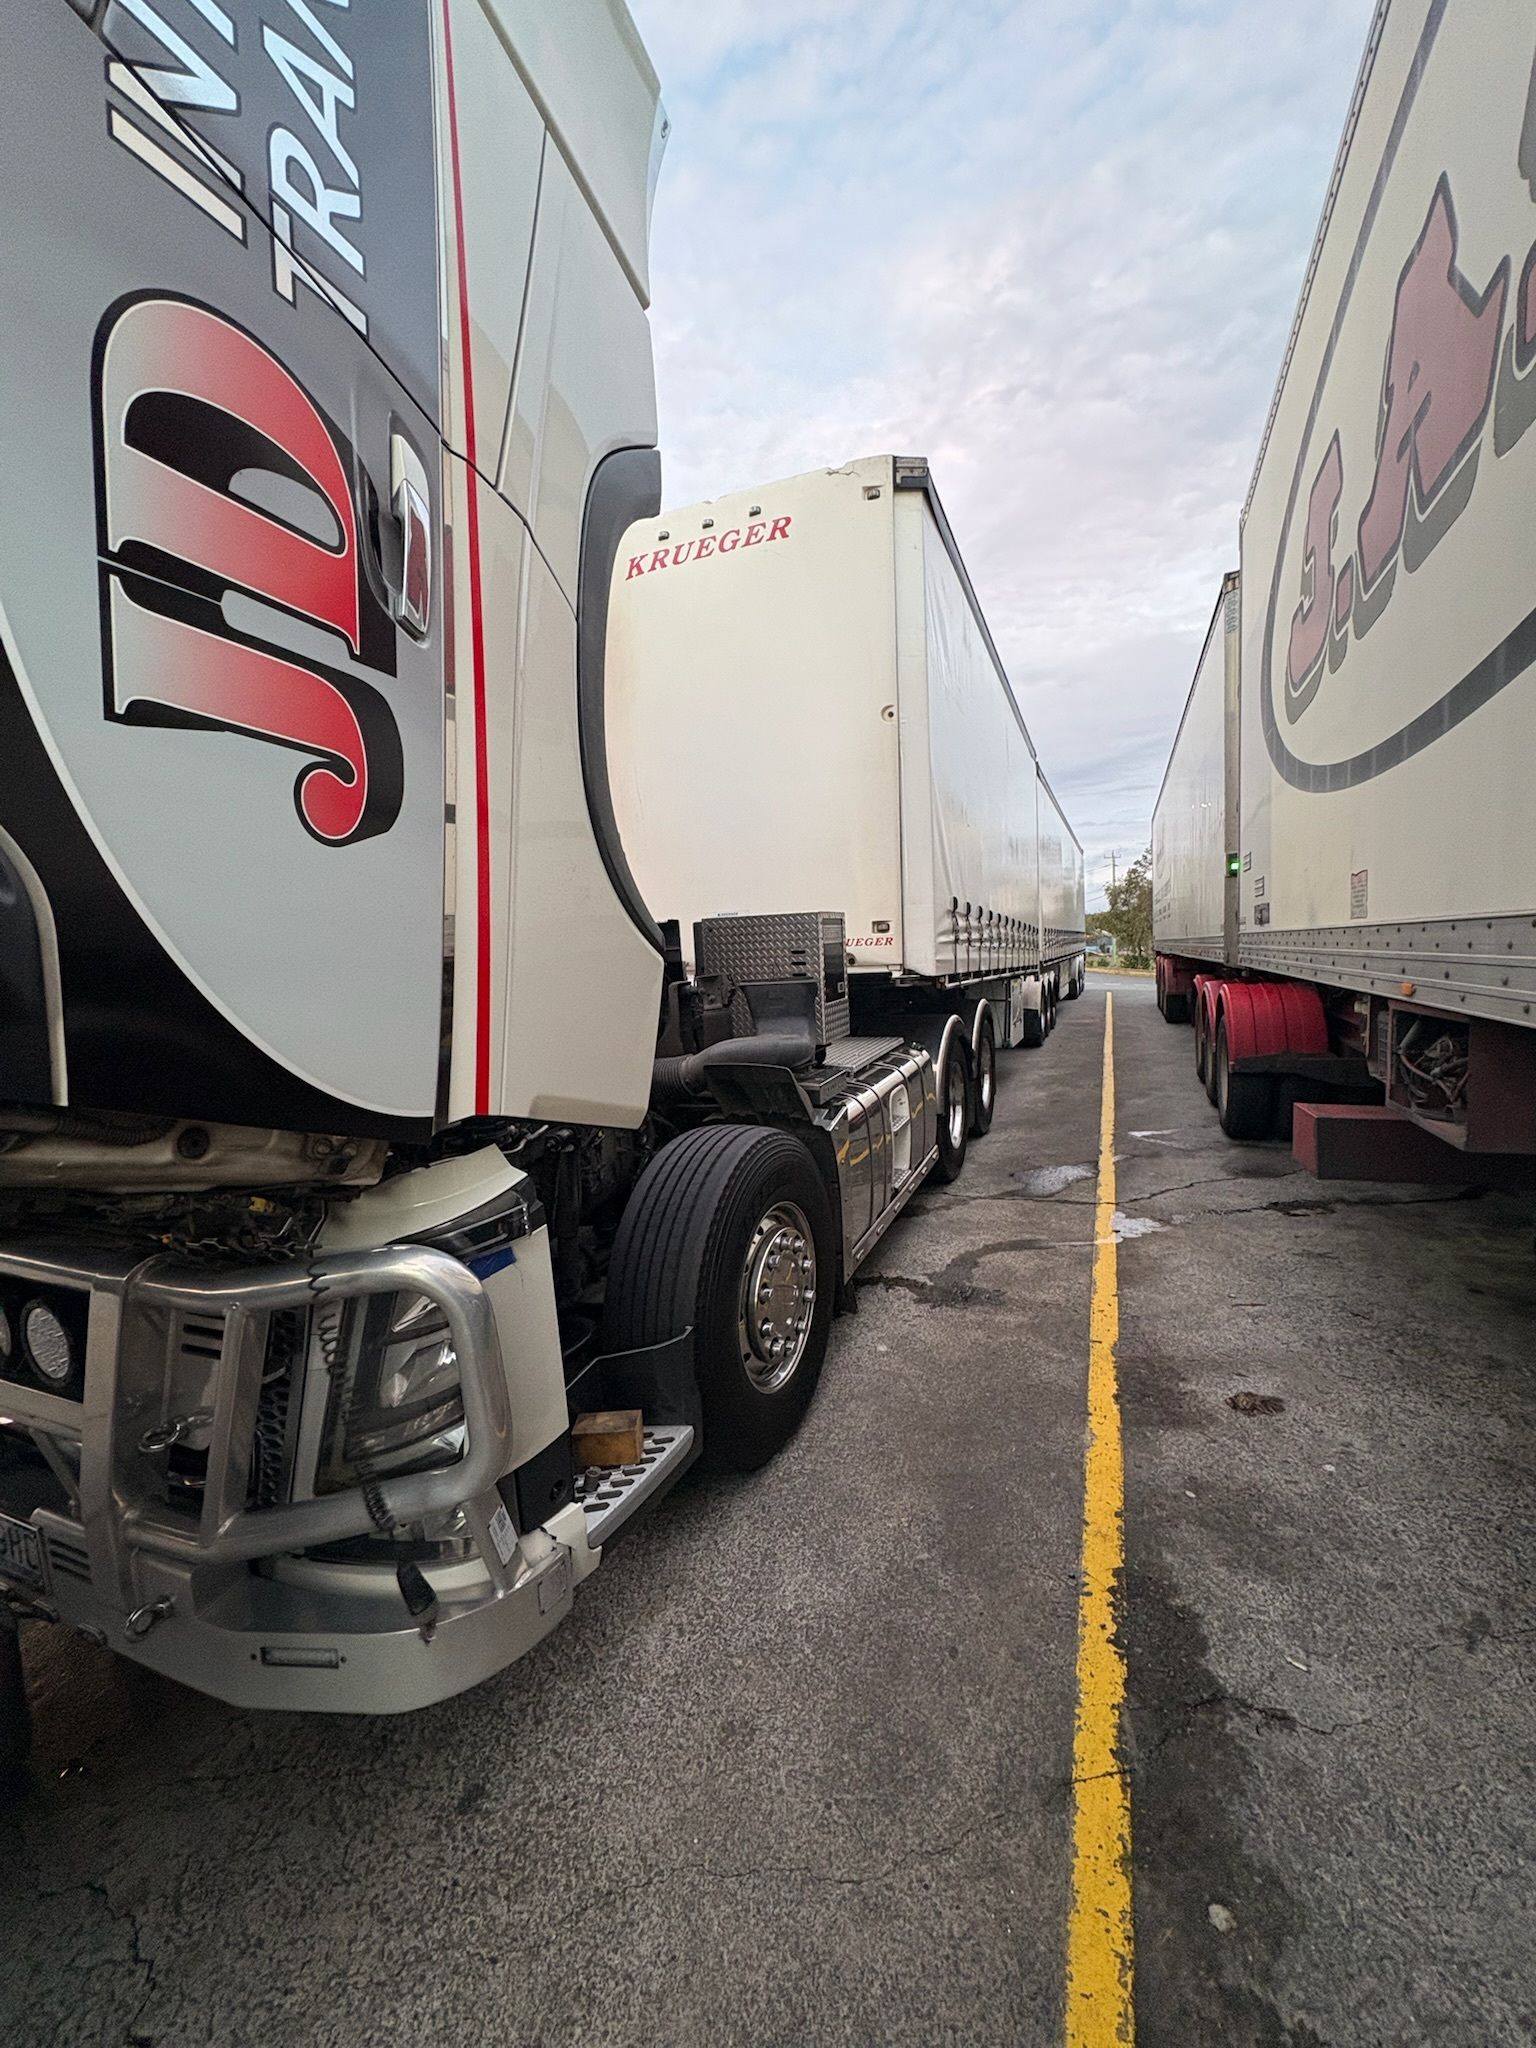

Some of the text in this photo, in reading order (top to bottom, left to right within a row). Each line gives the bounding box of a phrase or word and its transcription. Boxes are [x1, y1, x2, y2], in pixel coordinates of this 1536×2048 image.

[104, 0, 248, 249] IN
[91, 288, 404, 848] JD
[625, 515, 792, 580] KRUEGER
[846, 936, 893, 947] UEGER
